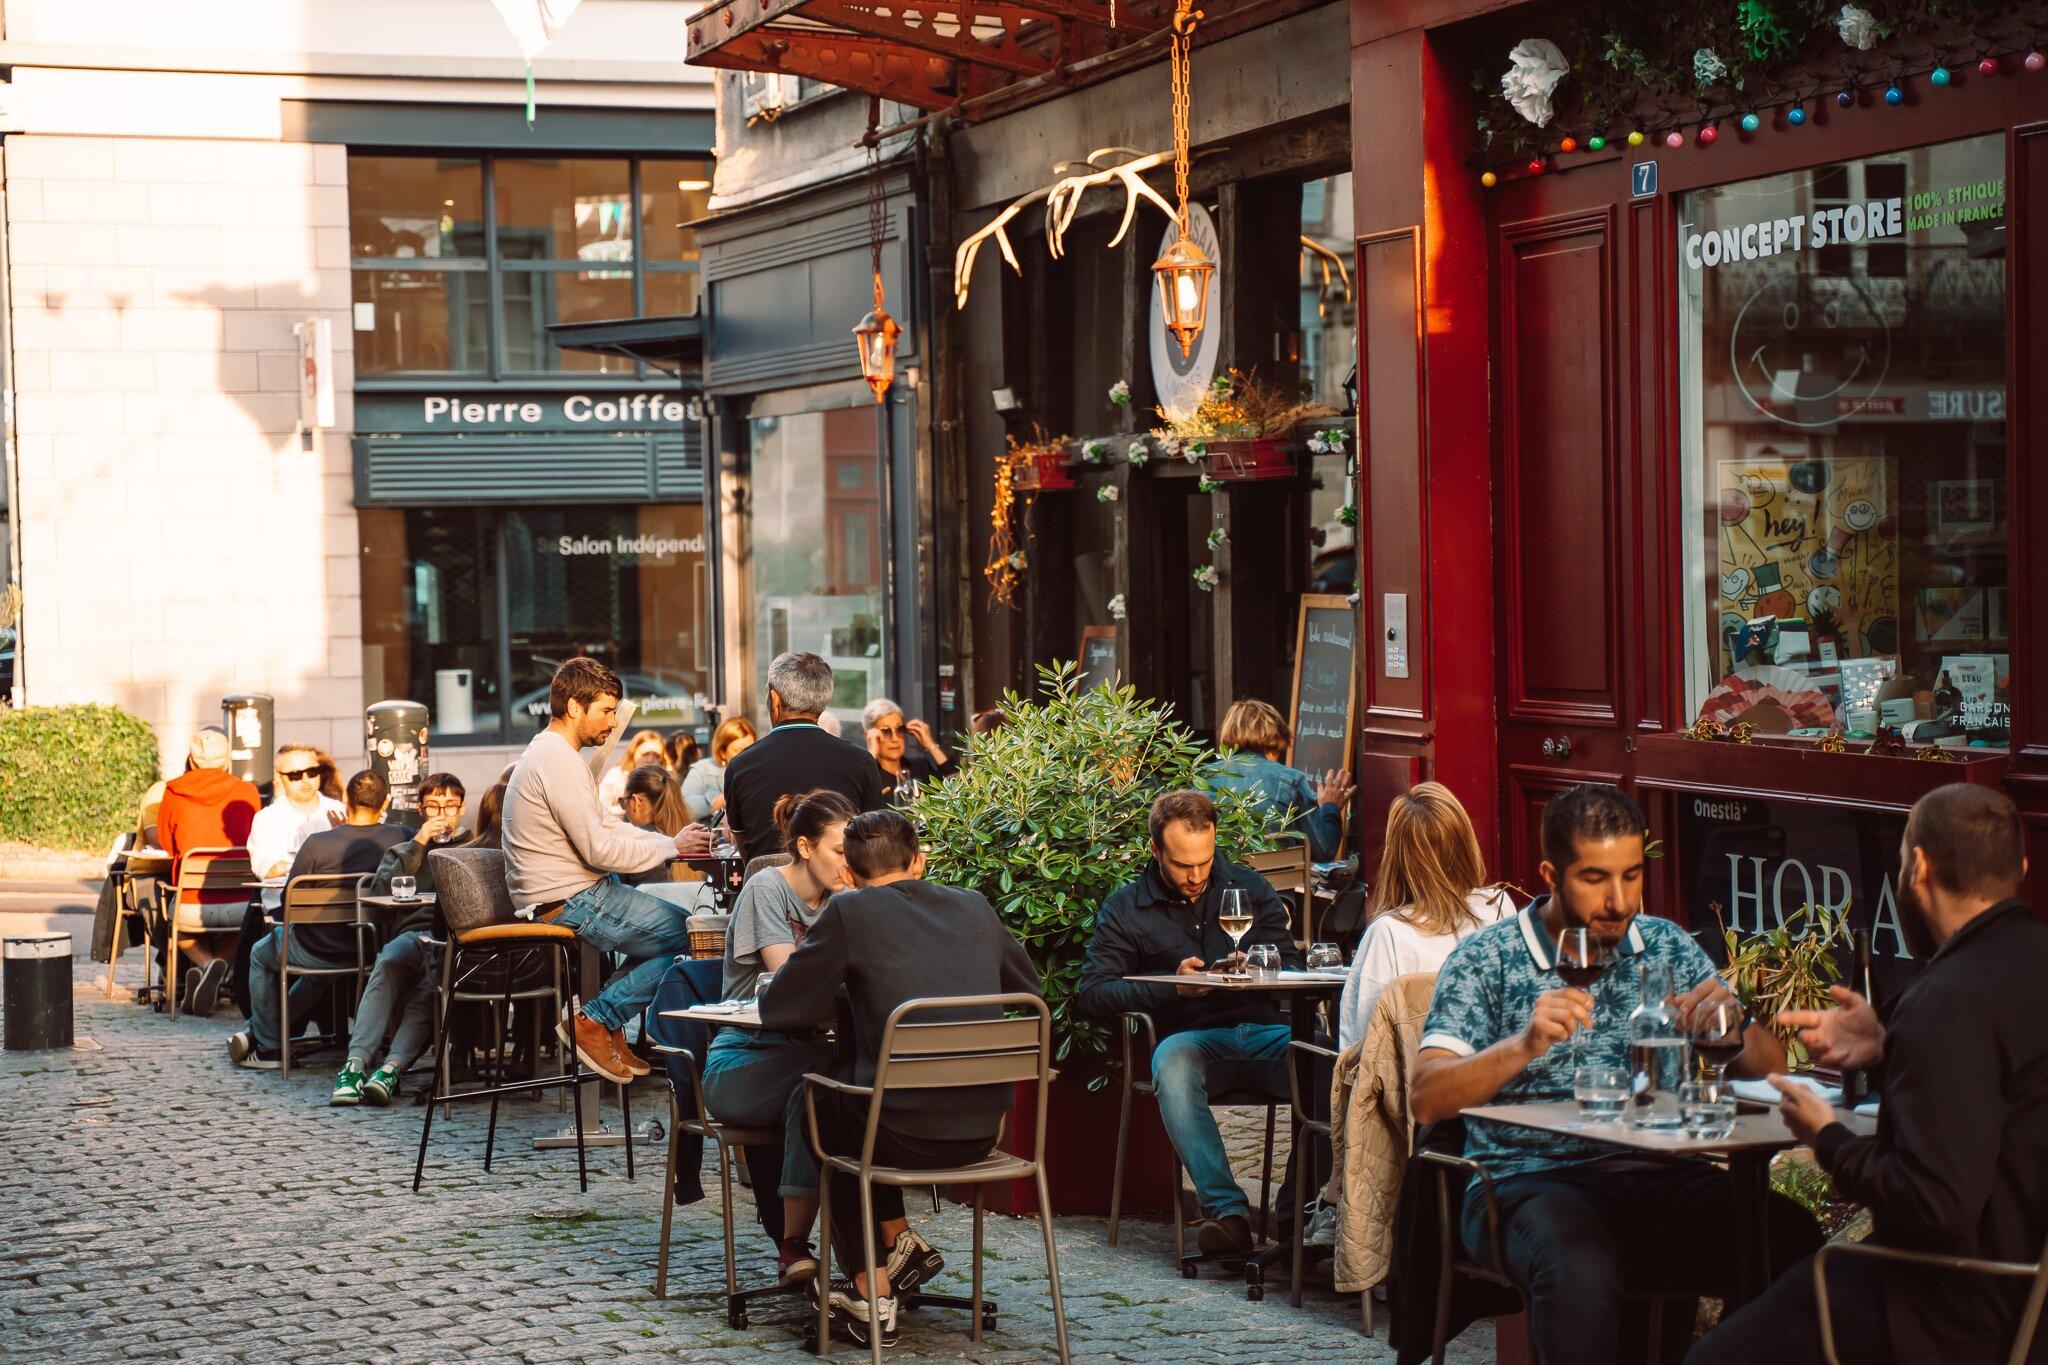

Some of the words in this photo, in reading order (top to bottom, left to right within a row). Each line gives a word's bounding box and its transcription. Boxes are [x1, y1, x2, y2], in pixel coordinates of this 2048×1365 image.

[1638, 164, 1650, 193] 7
[1906, 191, 1942, 212] 100%
[1947, 180, 2004, 205] ETHIQUE
[1906, 212, 1940, 232] MADE
[1942, 210, 1955, 226] IN
[1957, 203, 2004, 223] FRANCE
[1685, 215, 1806, 270] CONCEPT
[1811, 197, 1902, 249] STORE
[424, 396, 542, 424] Pierre
[558, 534, 612, 556] Salon
[617, 534, 705, 559] Indépend
